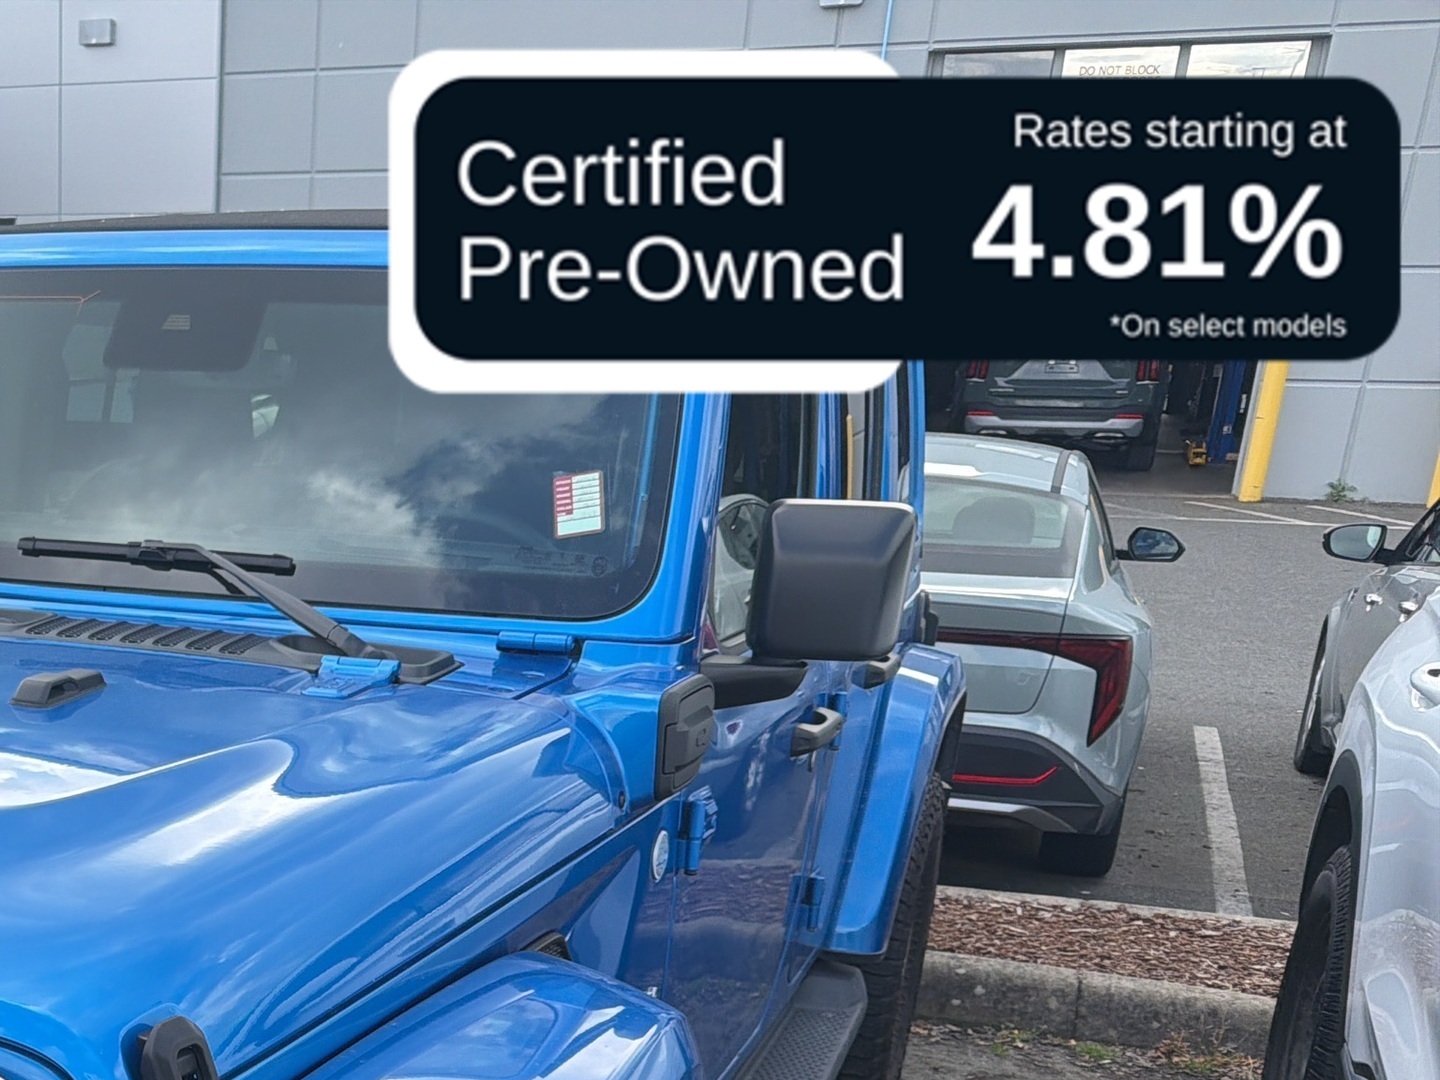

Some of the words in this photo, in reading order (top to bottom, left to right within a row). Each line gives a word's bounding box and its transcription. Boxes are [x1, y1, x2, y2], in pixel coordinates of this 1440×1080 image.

[1079, 66, 1096, 76] DO
[1098, 65, 1122, 76] NOT
[1125, 64, 1161, 75] BLOCK
